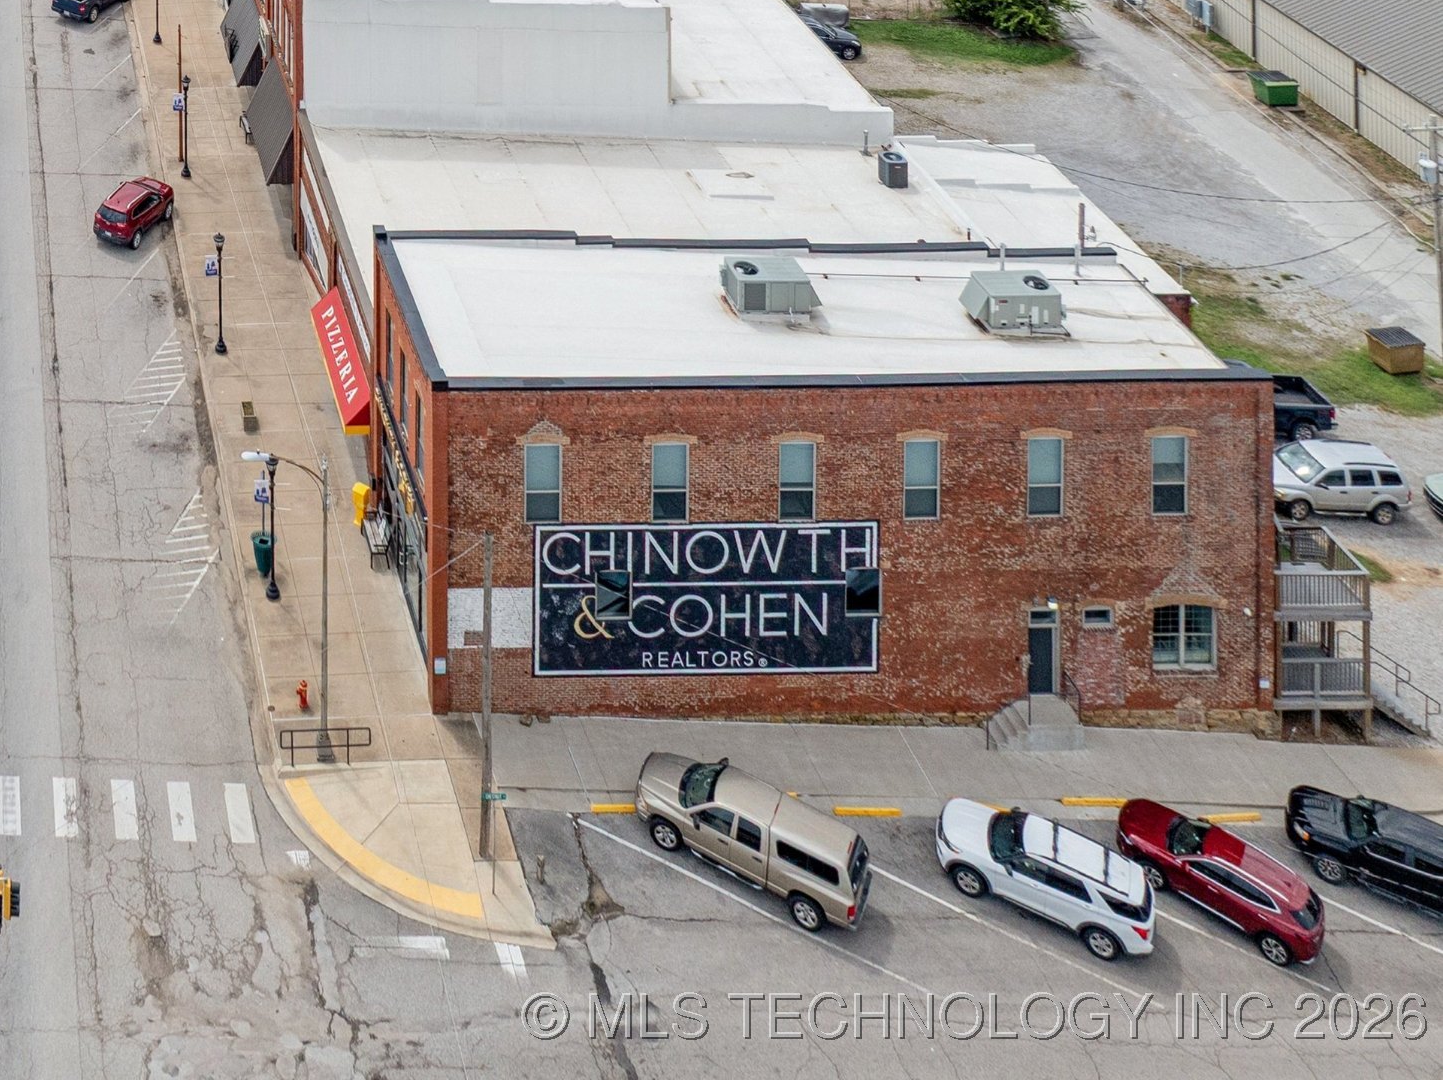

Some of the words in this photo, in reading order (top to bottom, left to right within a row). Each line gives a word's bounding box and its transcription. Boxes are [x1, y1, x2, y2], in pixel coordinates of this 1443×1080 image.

[321, 305, 359, 405] PIZZERIA
[573, 594, 615, 639] &
[627, 592, 828, 638] COHEN
